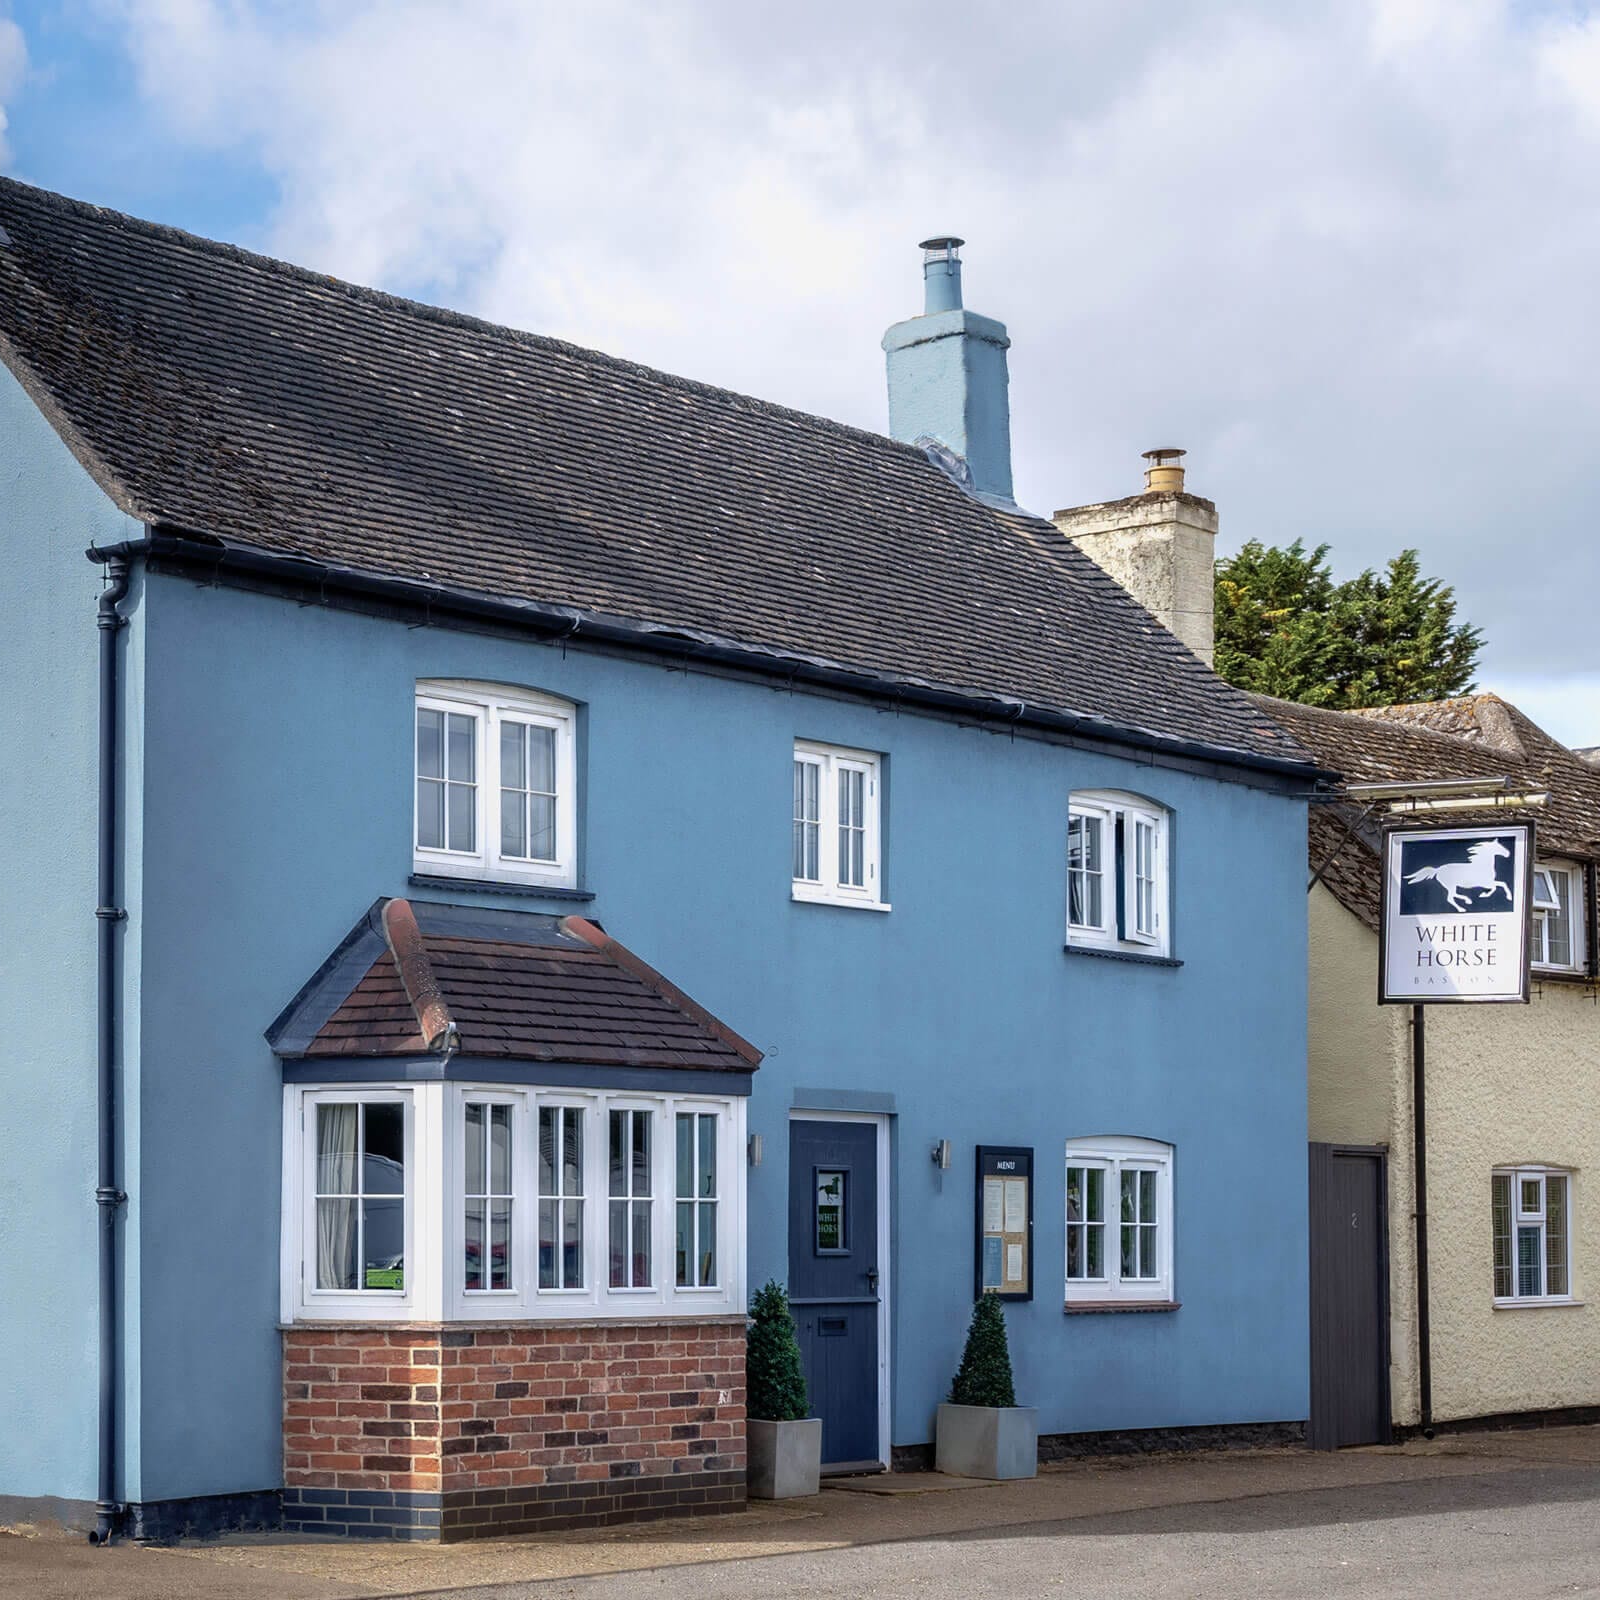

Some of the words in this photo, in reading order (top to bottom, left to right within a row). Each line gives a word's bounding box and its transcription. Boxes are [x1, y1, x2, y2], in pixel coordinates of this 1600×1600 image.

[1416, 924, 1497, 942] WHITE
[1417, 948, 1497, 967] HORSE
[997, 1161, 1015, 1170] MENU
[818, 1213, 838, 1222] WHIT
[817, 1224, 839, 1233] HORS
